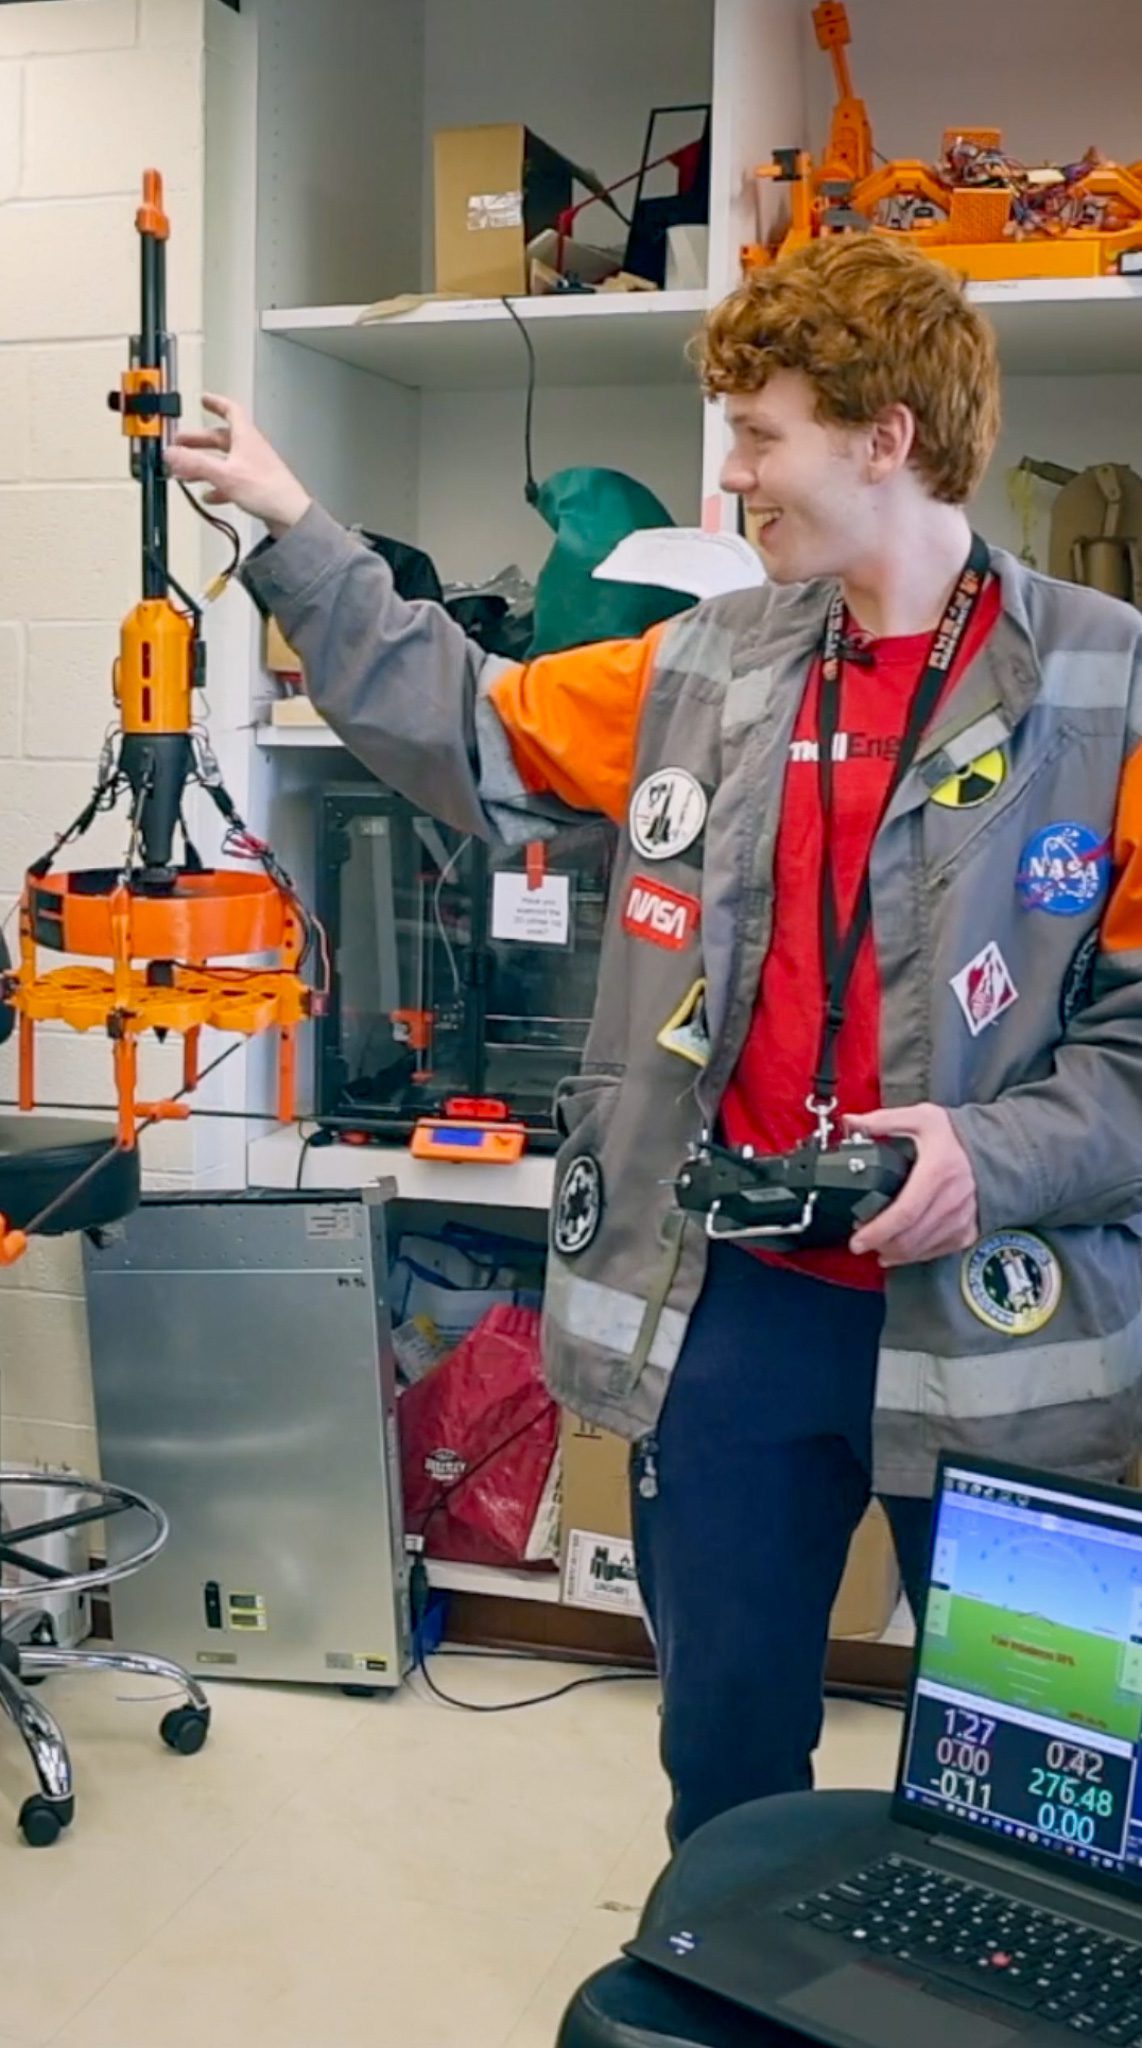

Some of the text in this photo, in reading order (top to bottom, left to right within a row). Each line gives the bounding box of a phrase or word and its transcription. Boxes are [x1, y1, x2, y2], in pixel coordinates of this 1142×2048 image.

[1029, 857, 1099, 880] NASA
[626, 888, 687, 939] NASA
[945, 1708, 996, 1746] 1.27
[936, 1738, 1105, 1783] 0.00 0.42
[930, 1767, 1114, 1817] -0.11 276.48
[1037, 1802, 1095, 1844] 0.00
